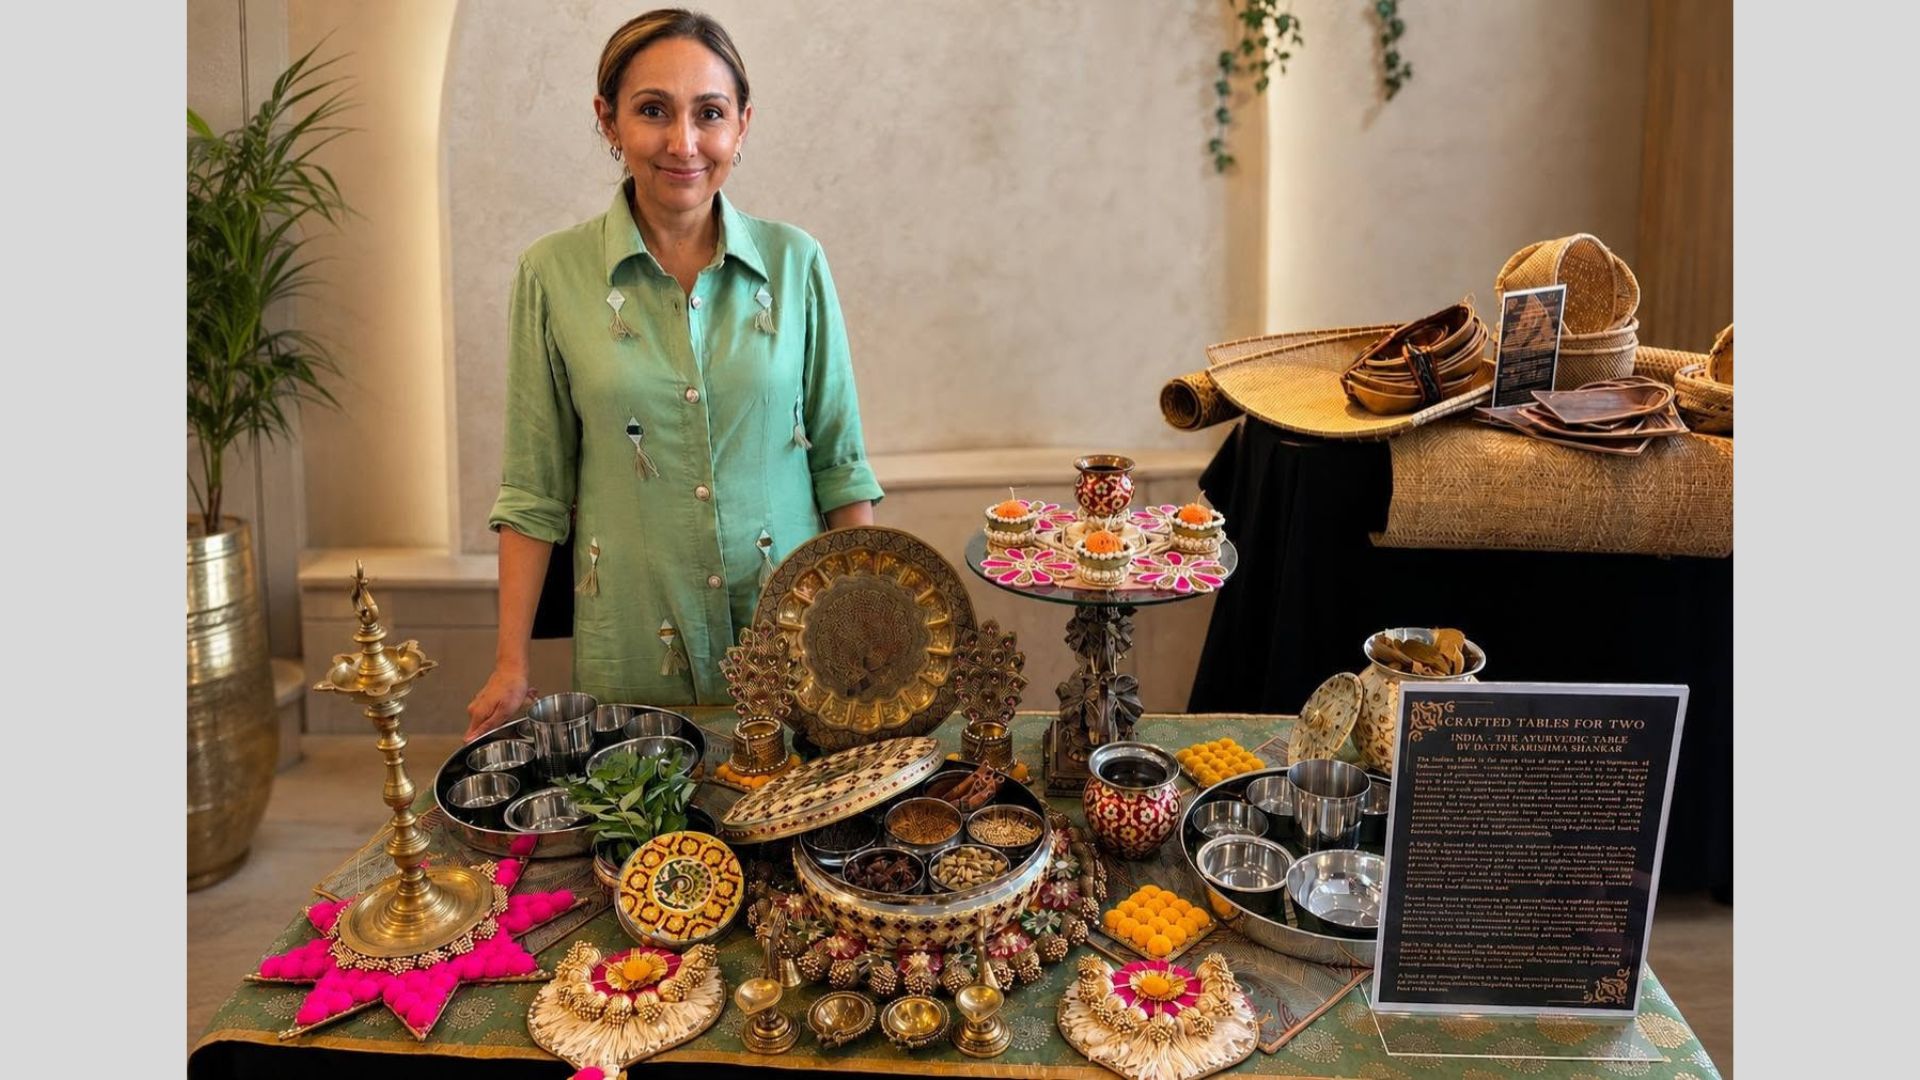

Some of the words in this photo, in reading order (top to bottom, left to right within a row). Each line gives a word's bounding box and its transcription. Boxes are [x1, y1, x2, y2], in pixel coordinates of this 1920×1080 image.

[1444, 717, 1511, 728] CRAFTED
[1517, 718, 1569, 729] TABLES
[1574, 719, 1602, 729] FOR
[1609, 719, 1645, 730] TWO
[1451, 733, 1483, 742] INDIA
[1495, 734, 1518, 743] THE
[1522, 735, 1588, 744] AYURVEDIC
[1592, 735, 1629, 744] TABLE
[1474, 743, 1507, 752] DATIN
[1571, 744, 1623, 753] SHANKAR
